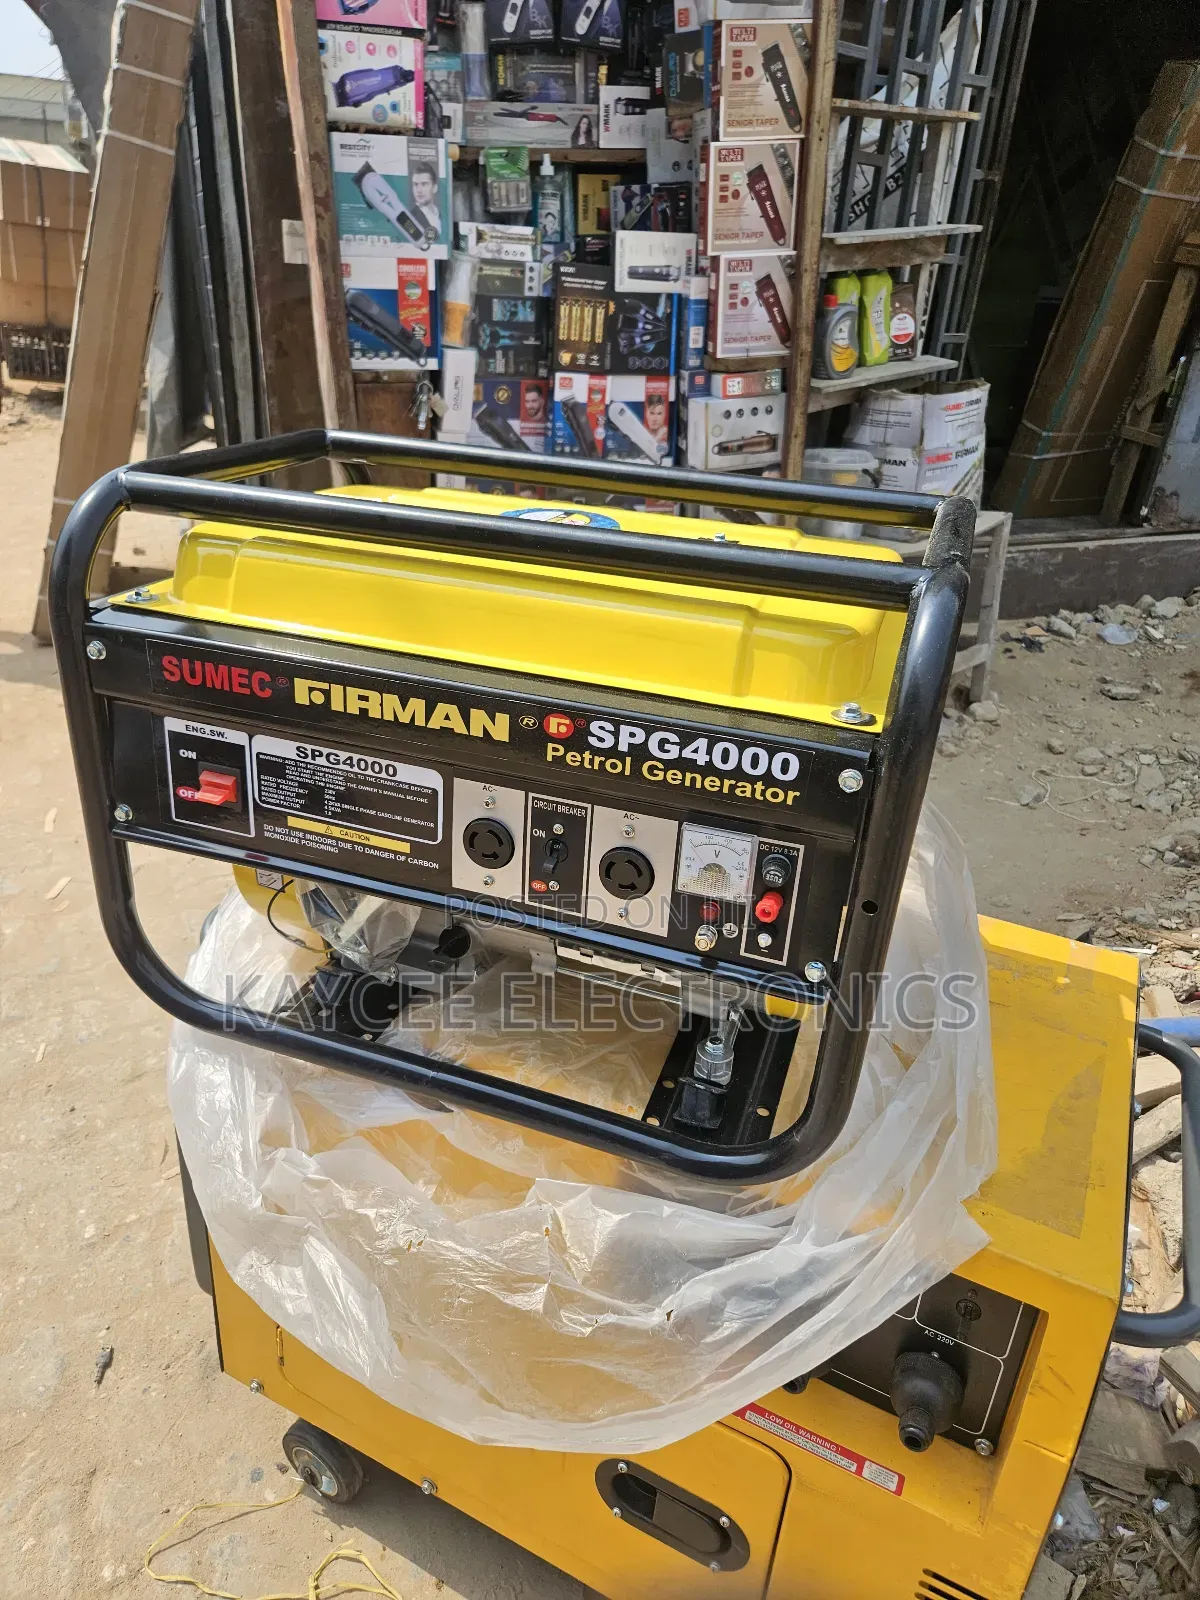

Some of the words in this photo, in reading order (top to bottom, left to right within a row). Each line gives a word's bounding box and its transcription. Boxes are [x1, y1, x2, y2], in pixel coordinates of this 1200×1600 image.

[603, 104, 611, 133] WMARK
[727, 119, 754, 127] SENIOR
[755, 118, 780, 126] TAPER
[724, 336, 748, 344] SENIOR
[965, 398, 982, 407] FIRMAN
[925, 452, 952, 464] SUMEC
[955, 445, 979, 459] FIRMAN
[162, 655, 272, 698] SUMEC
[294, 677, 510, 742] FIRMAN
[588, 720, 800, 782] SPG4000
[185, 724, 228, 739] ENG.SW.
[179, 749, 197, 760] ON
[295, 745, 398, 778] SPG4000
[260, 774, 276, 782] RATED
[277, 777, 298, 787] VOLTAGE
[286, 774, 314, 784] OPERATING
[307, 763, 346, 776] RECOMMENDED
[377, 778, 409, 790] CRANKCASE
[410, 785, 432, 795] BEFORE
[547, 743, 631, 776] Petrol
[641, 760, 801, 806] Generator
[260, 779, 276, 788] RATED
[280, 784, 307, 794] FREQUENCY
[261, 785, 276, 793] RATED
[277, 788, 295, 797] OUTPUT
[312, 774, 345, 786] UNDERSTAND
[384, 790, 405, 799] MANUAL
[406, 794, 428, 804] BEFORE
[261, 790, 283, 800] MAXIMUM
[286, 795, 304, 804] OUTPUT
[261, 795, 279, 804] POWER
[281, 799, 300, 809] FACTOR
[341, 803, 359, 812] SINGLE
[359, 806, 376, 815] PHASE
[378, 810, 402, 821] GASOLINE
[404, 816, 434, 828] GENERATOR
[533, 800, 556, 812] CIRCUIT
[557, 804, 586, 817] BREAKER
[339, 829, 370, 842] CAUTION
[532, 828, 546, 838] ON
[264, 831, 300, 845] MONOXIDE
[301, 839, 339, 854] POISONING
[275, 826, 290, 835] NOT
[290, 829, 304, 838] USE
[305, 833, 337, 846] INDOORS
[338, 840, 352, 850] DUE
[354, 844, 364, 853] TO
[365, 847, 395, 860] DANGER
[396, 854, 406, 862] OF
[408, 857, 439, 870] CARBON
[714, 849, 721, 858] V
[771, 846, 783, 854] 12V
[784, 849, 798, 857] 8.3A
[765, 873, 783, 884] FUSE
[533, 882, 546, 890] OFF
[924, 1329, 936, 1338] AC
[937, 1334, 956, 1346] 220V
[765, 1412, 784, 1426] LOW
[784, 1420, 797, 1433] OIL
[798, 1428, 837, 1451] WARNING
